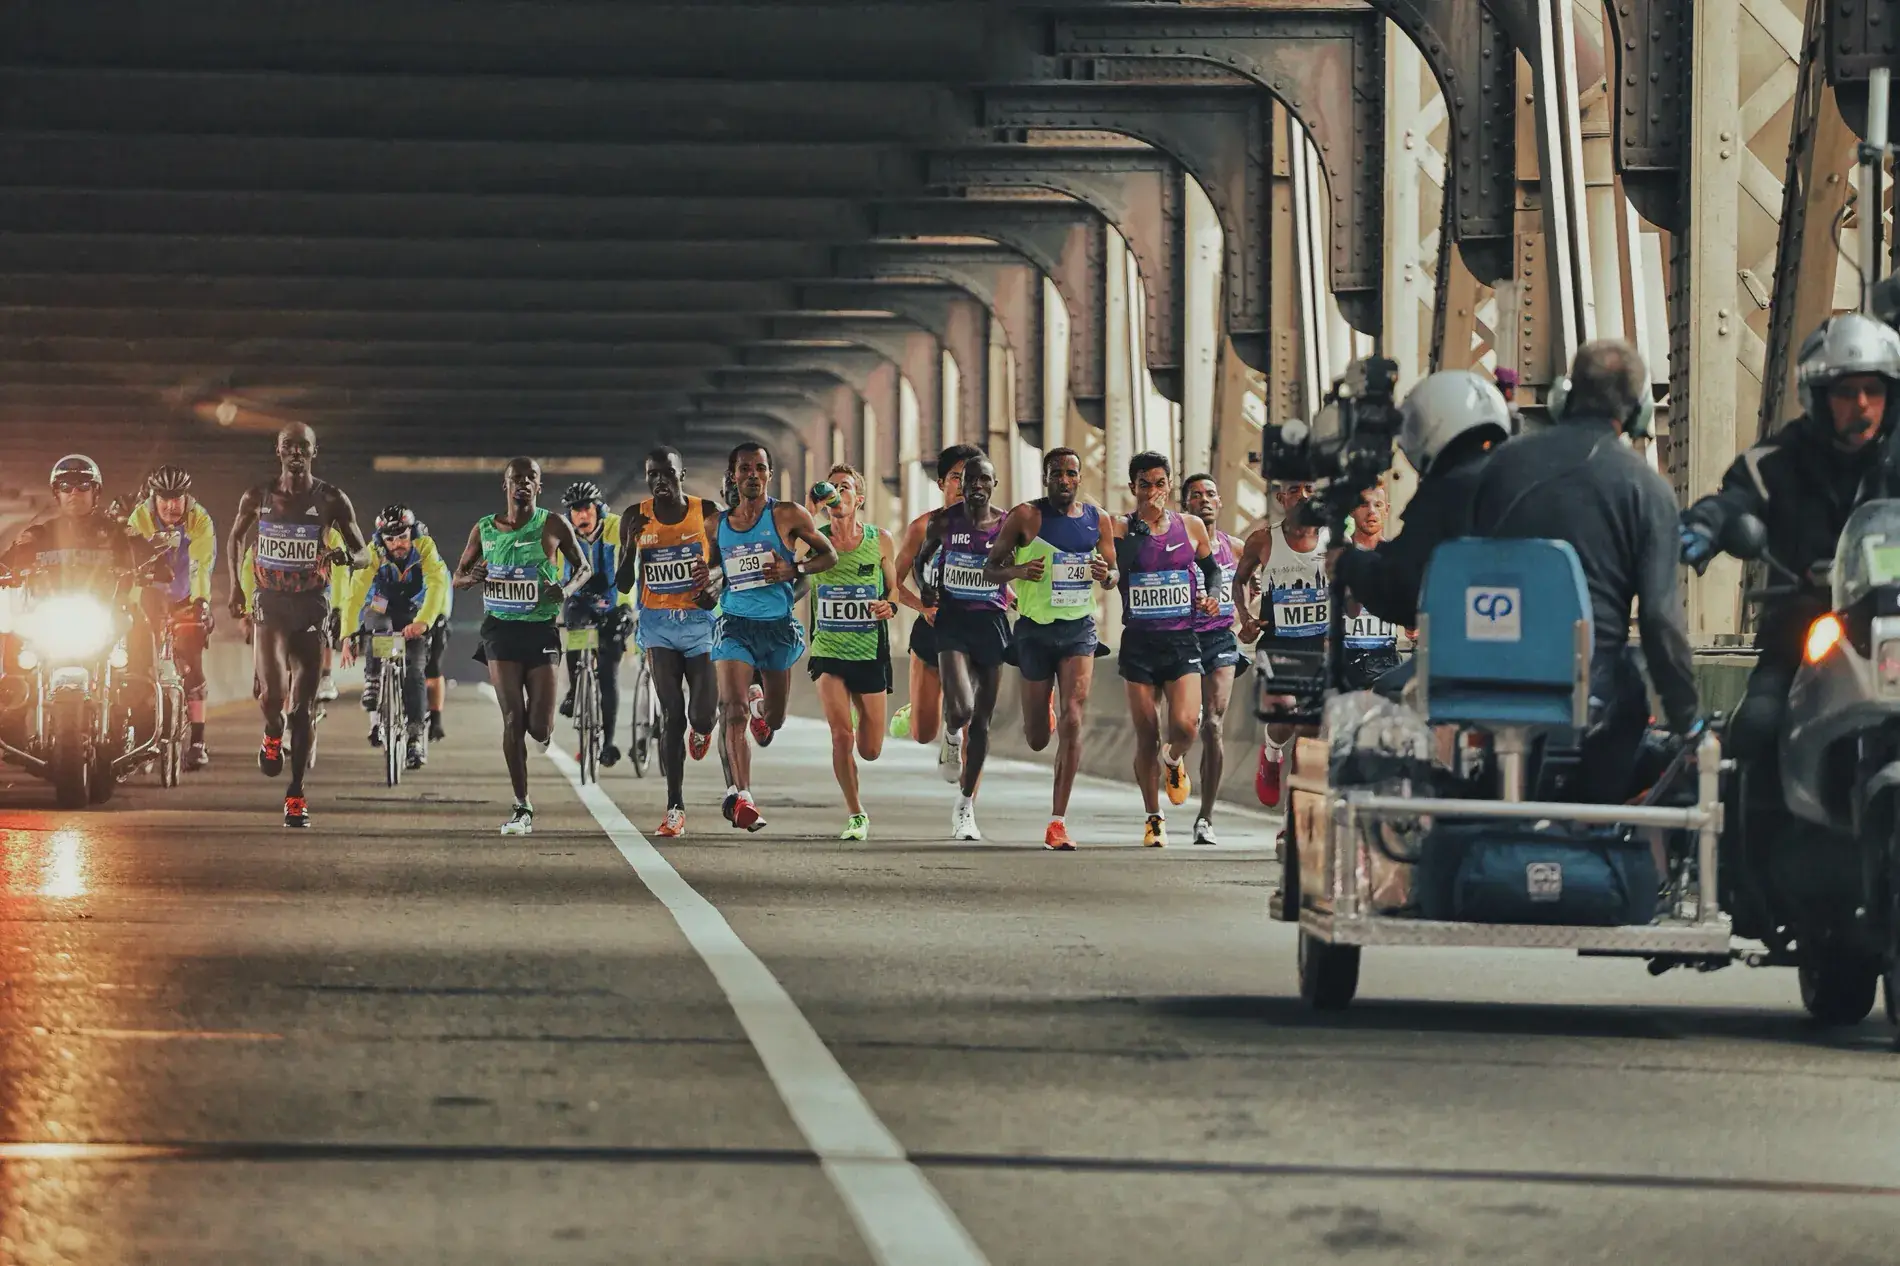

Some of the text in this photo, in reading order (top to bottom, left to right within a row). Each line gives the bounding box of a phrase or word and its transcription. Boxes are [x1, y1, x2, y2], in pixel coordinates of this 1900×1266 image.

[260, 537, 315, 560] KIPSANG
[482, 540, 496, 551] RC
[640, 534, 658, 545] NRC
[951, 533, 971, 545] NRC
[645, 560, 698, 582] BIWOT
[739, 556, 760, 572] 259
[1067, 566, 1085, 579] 249
[484, 581, 536, 601] CHELIMO
[1132, 586, 1189, 607] BARRIOS
[822, 601, 873, 620] LEON
[1283, 604, 1327, 625] MEB
[1345, 618, 1393, 637] ALLI
